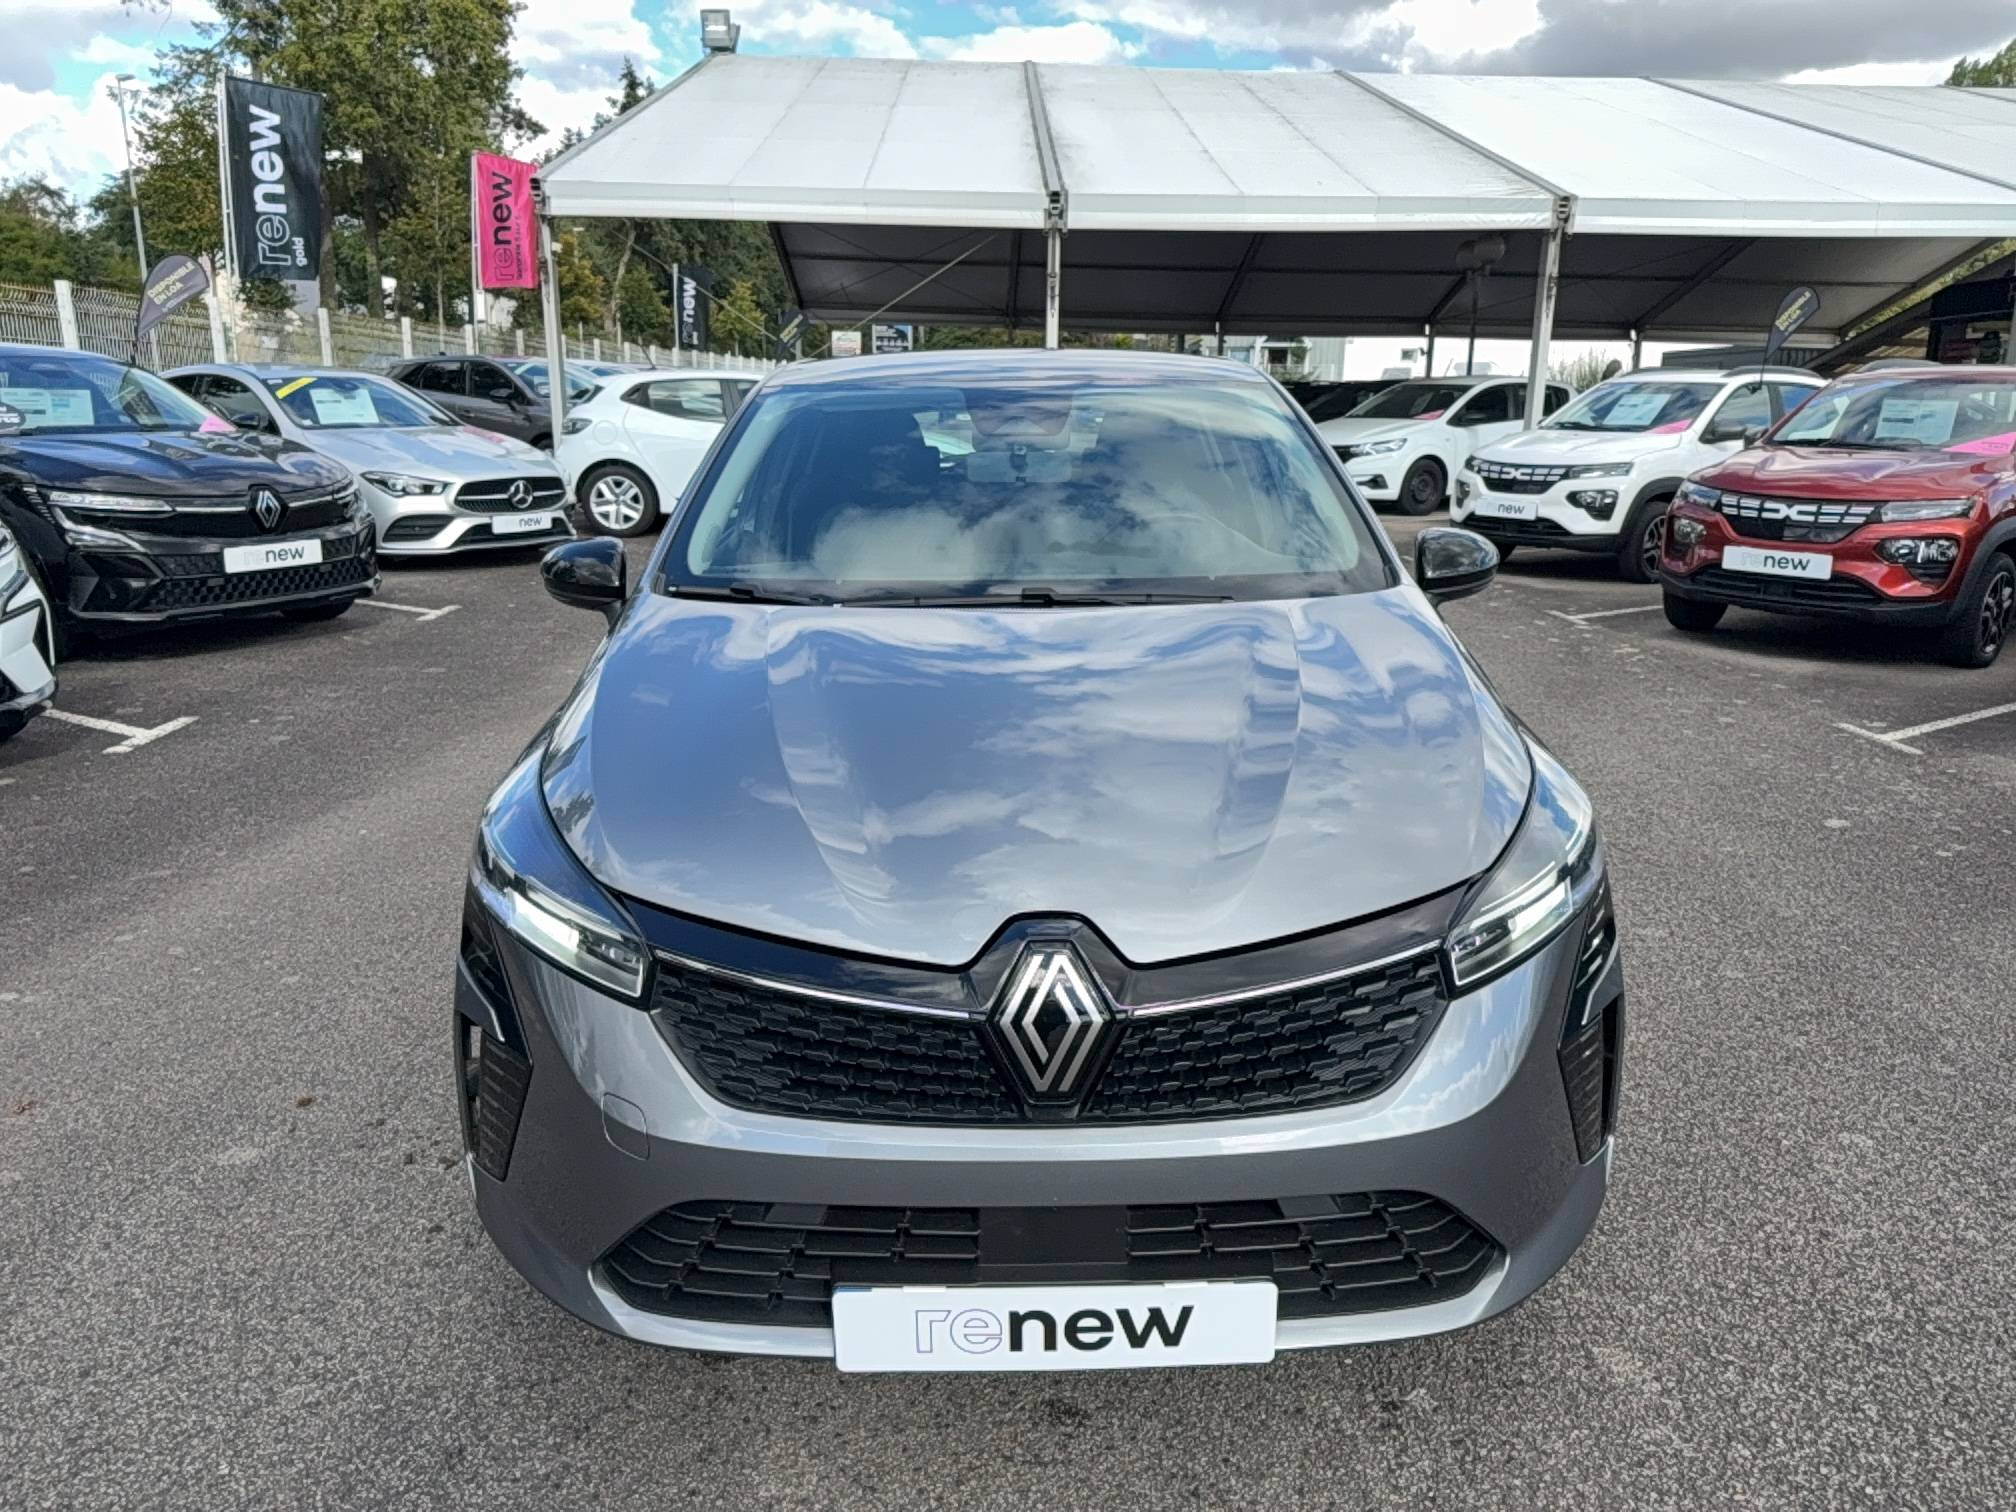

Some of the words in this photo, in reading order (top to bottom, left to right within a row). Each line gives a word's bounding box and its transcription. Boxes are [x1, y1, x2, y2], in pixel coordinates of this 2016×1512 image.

[249, 104, 291, 266] renew
[292, 237, 308, 267] gold
[492, 172, 513, 281] renew
[915, 1305, 1194, 1354] renew
